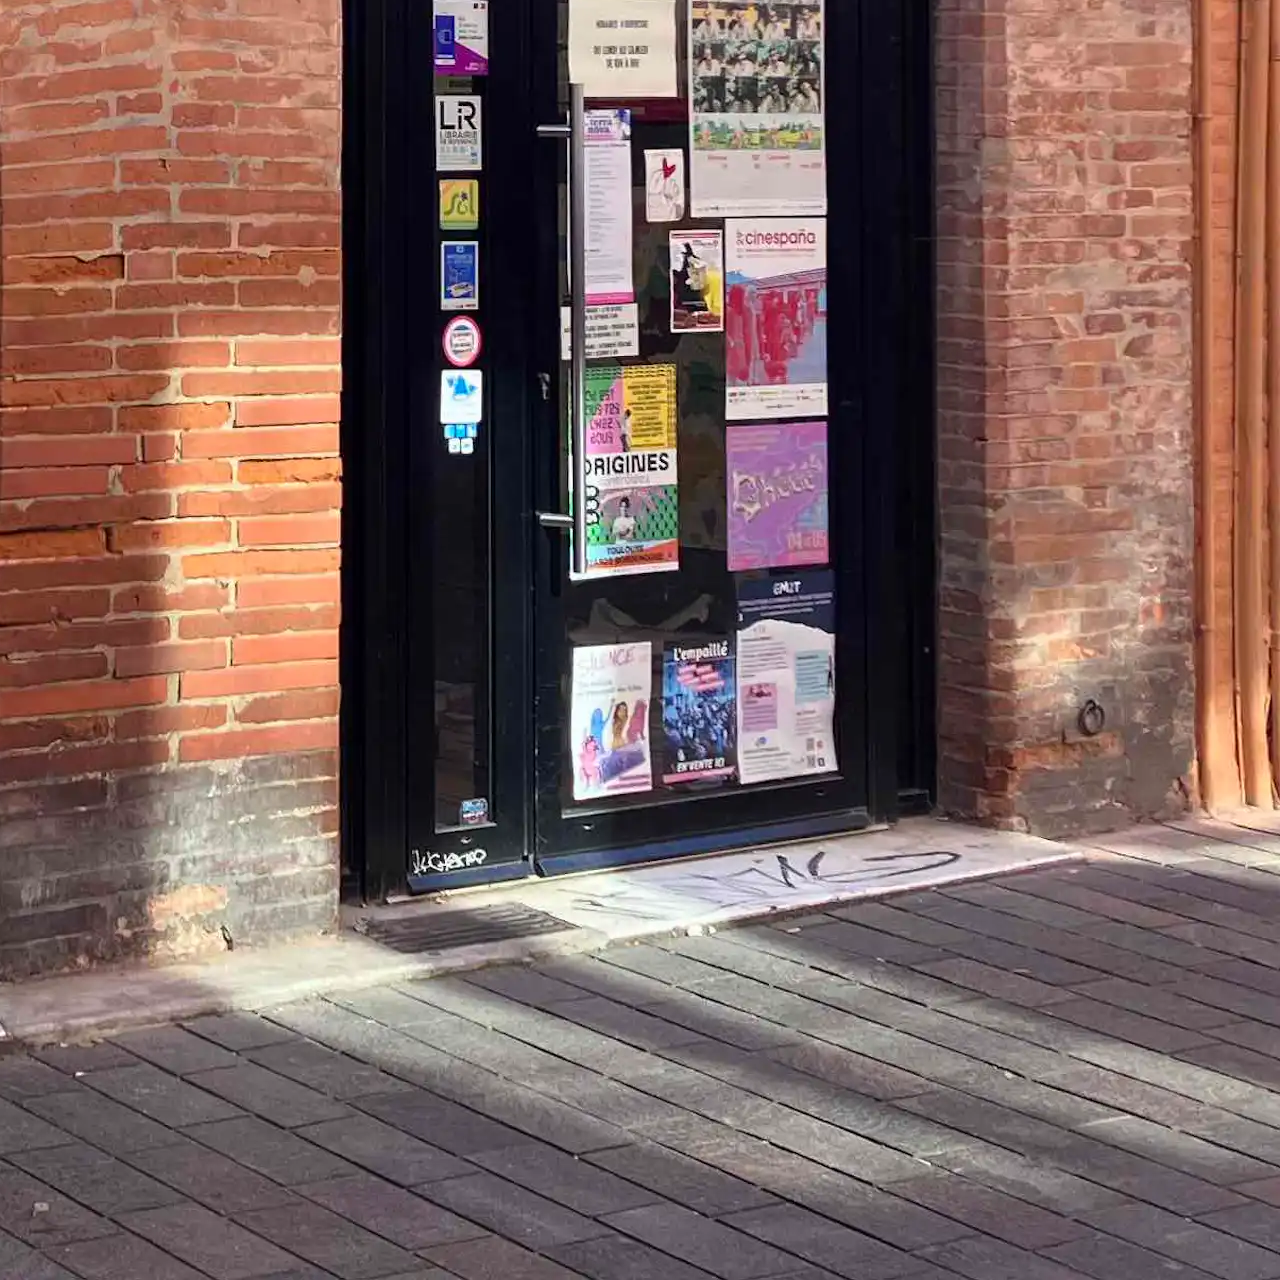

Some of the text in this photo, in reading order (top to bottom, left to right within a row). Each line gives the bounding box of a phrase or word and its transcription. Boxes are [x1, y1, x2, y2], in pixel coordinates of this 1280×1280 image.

[745, 228, 817, 247] cinespaña
[585, 453, 669, 476] ORIGINES
[673, 640, 728, 662] L'empaillé
